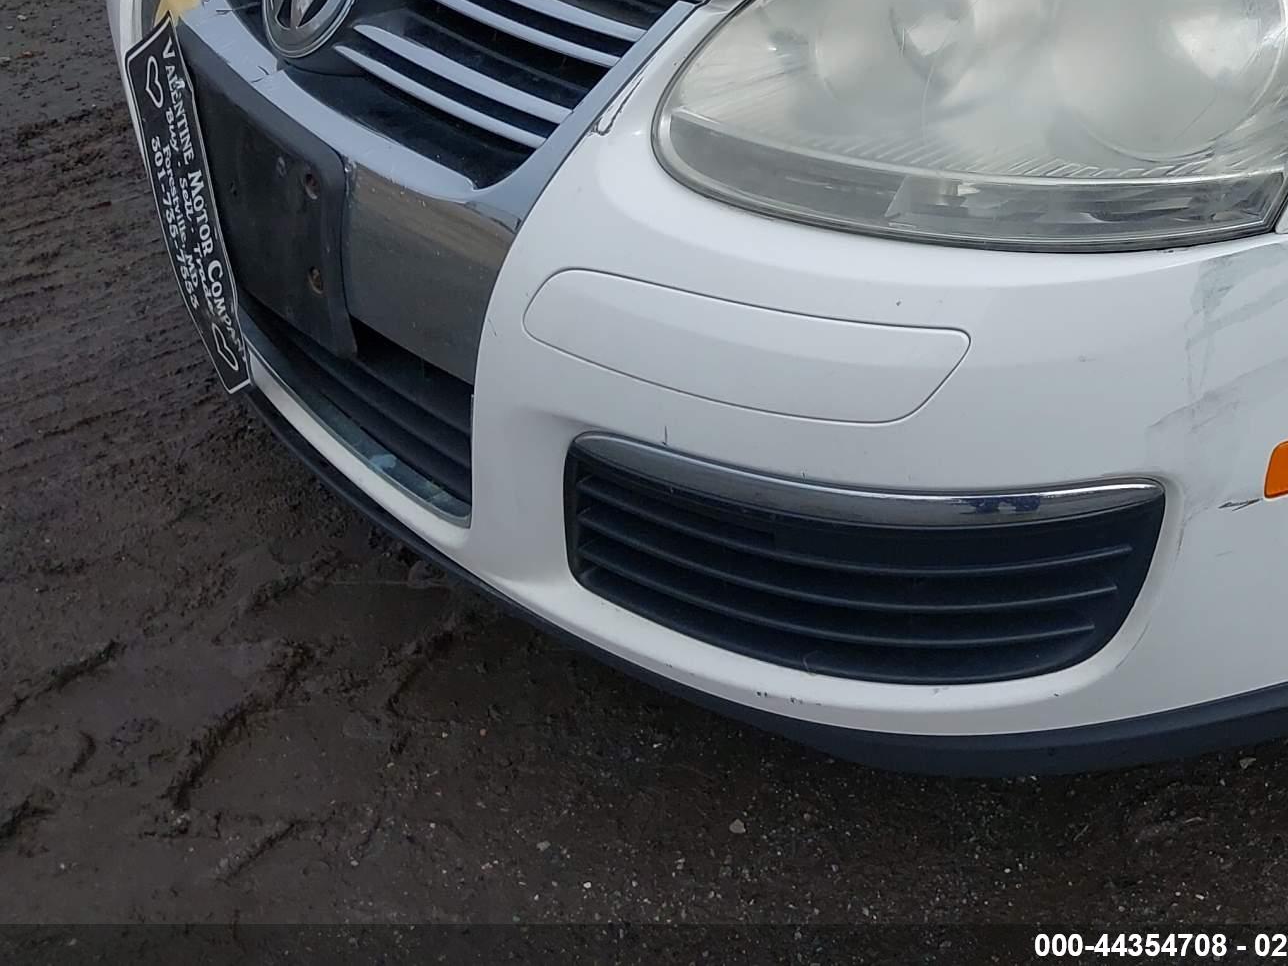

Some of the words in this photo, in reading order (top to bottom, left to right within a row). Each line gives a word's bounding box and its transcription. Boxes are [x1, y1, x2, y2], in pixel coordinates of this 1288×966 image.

[162, 35, 196, 166] VALENTINE
[187, 169, 214, 258] MOTOR
[165, 106, 180, 153] Buy
[179, 177, 195, 223] Sell
[184, 254, 199, 288] MD
